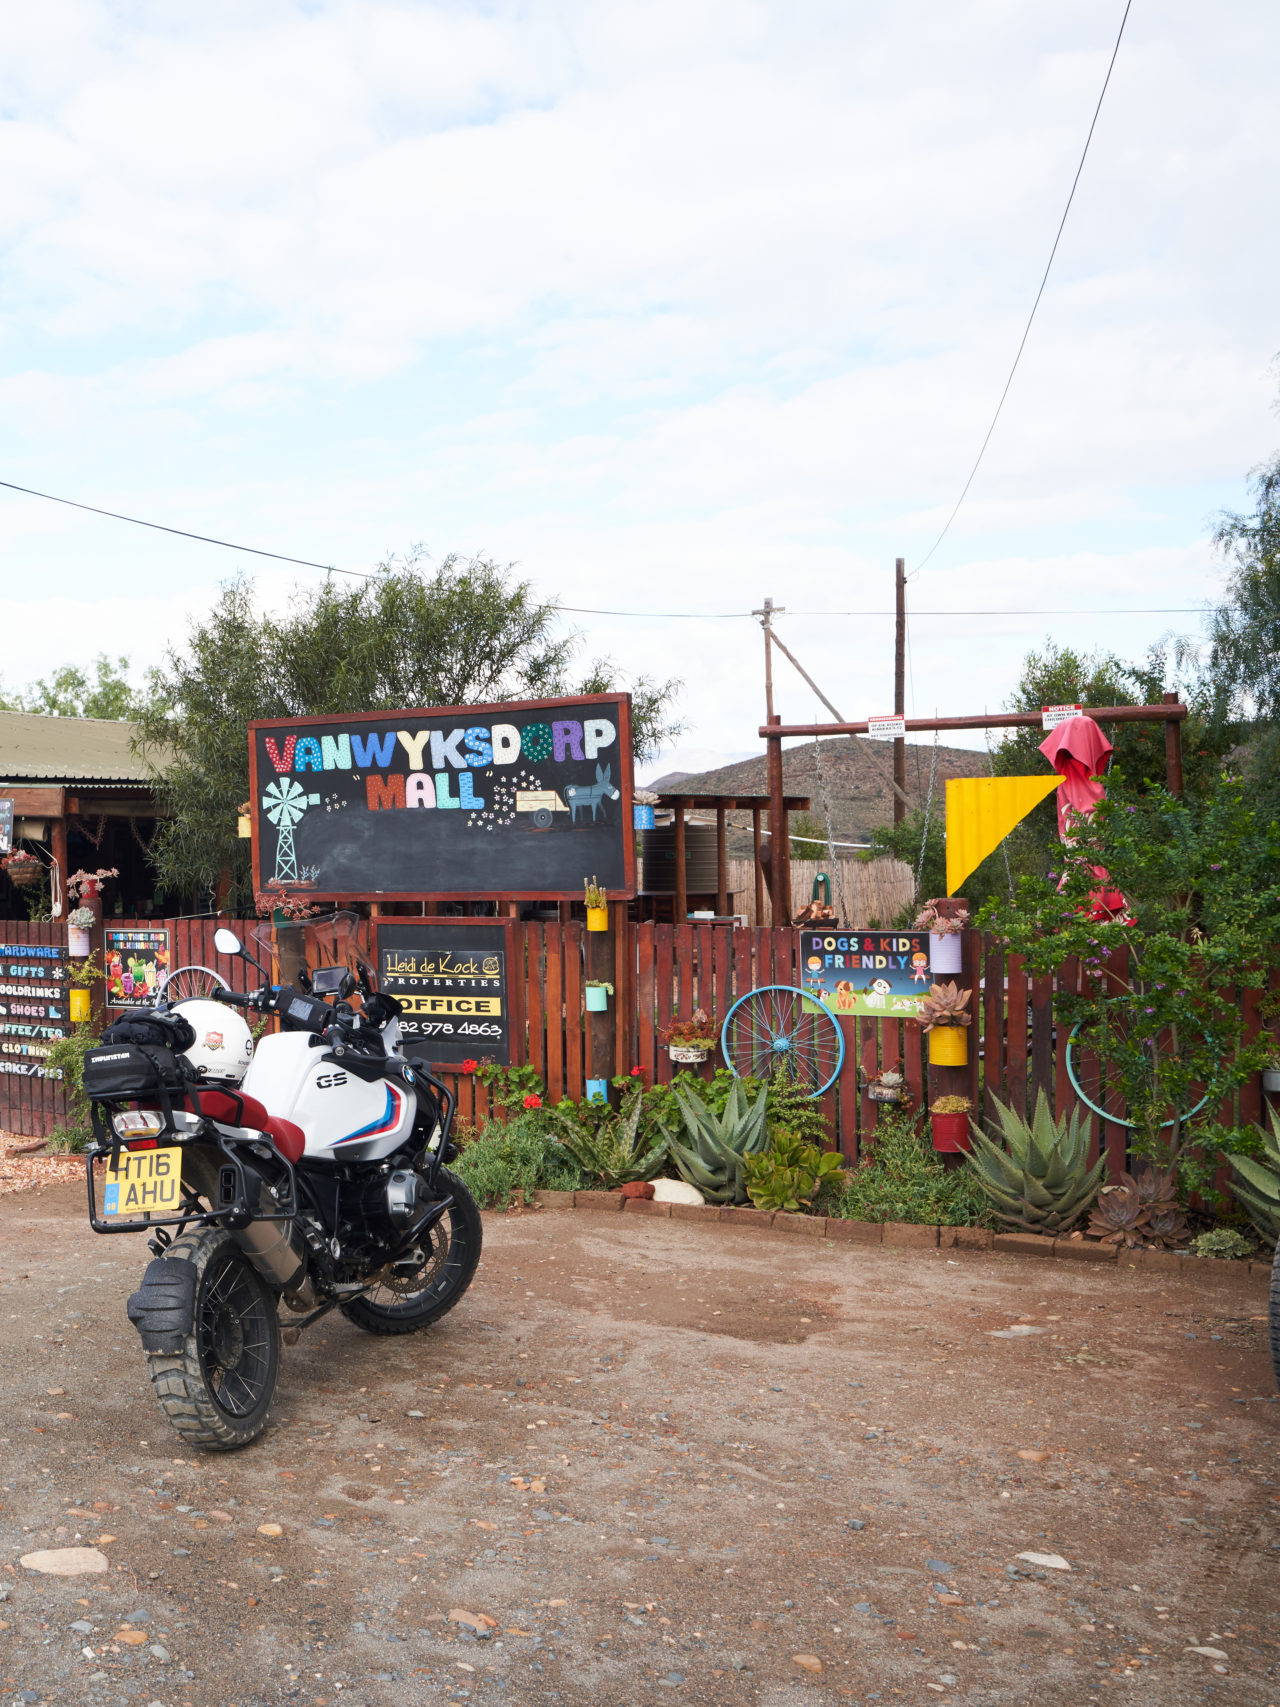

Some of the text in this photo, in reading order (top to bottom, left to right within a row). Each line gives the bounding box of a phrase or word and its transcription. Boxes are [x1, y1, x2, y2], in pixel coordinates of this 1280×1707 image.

[265, 718, 617, 773] VANWYKSDORP
[108, 933, 165, 941] SMOOTHIES AND
[812, 937, 921, 952] DOGS & KIDS
[114, 941, 159, 950] MILKSHAKES
[386, 953, 479, 974] Heidi de Kock
[825, 955, 909, 969] FRIENDLY
[9, 965, 45, 977] GIFTS
[385, 978, 500, 987] PROPERTIES
[10, 1003, 46, 1017] SHOES
[397, 998, 491, 1013] OFFICE
[397, 1021, 503, 1036] 82 978 4863
[316, 1072, 348, 1089] GS
[113, 1154, 171, 1181] HT16
[125, 1179, 175, 1206] AHU
